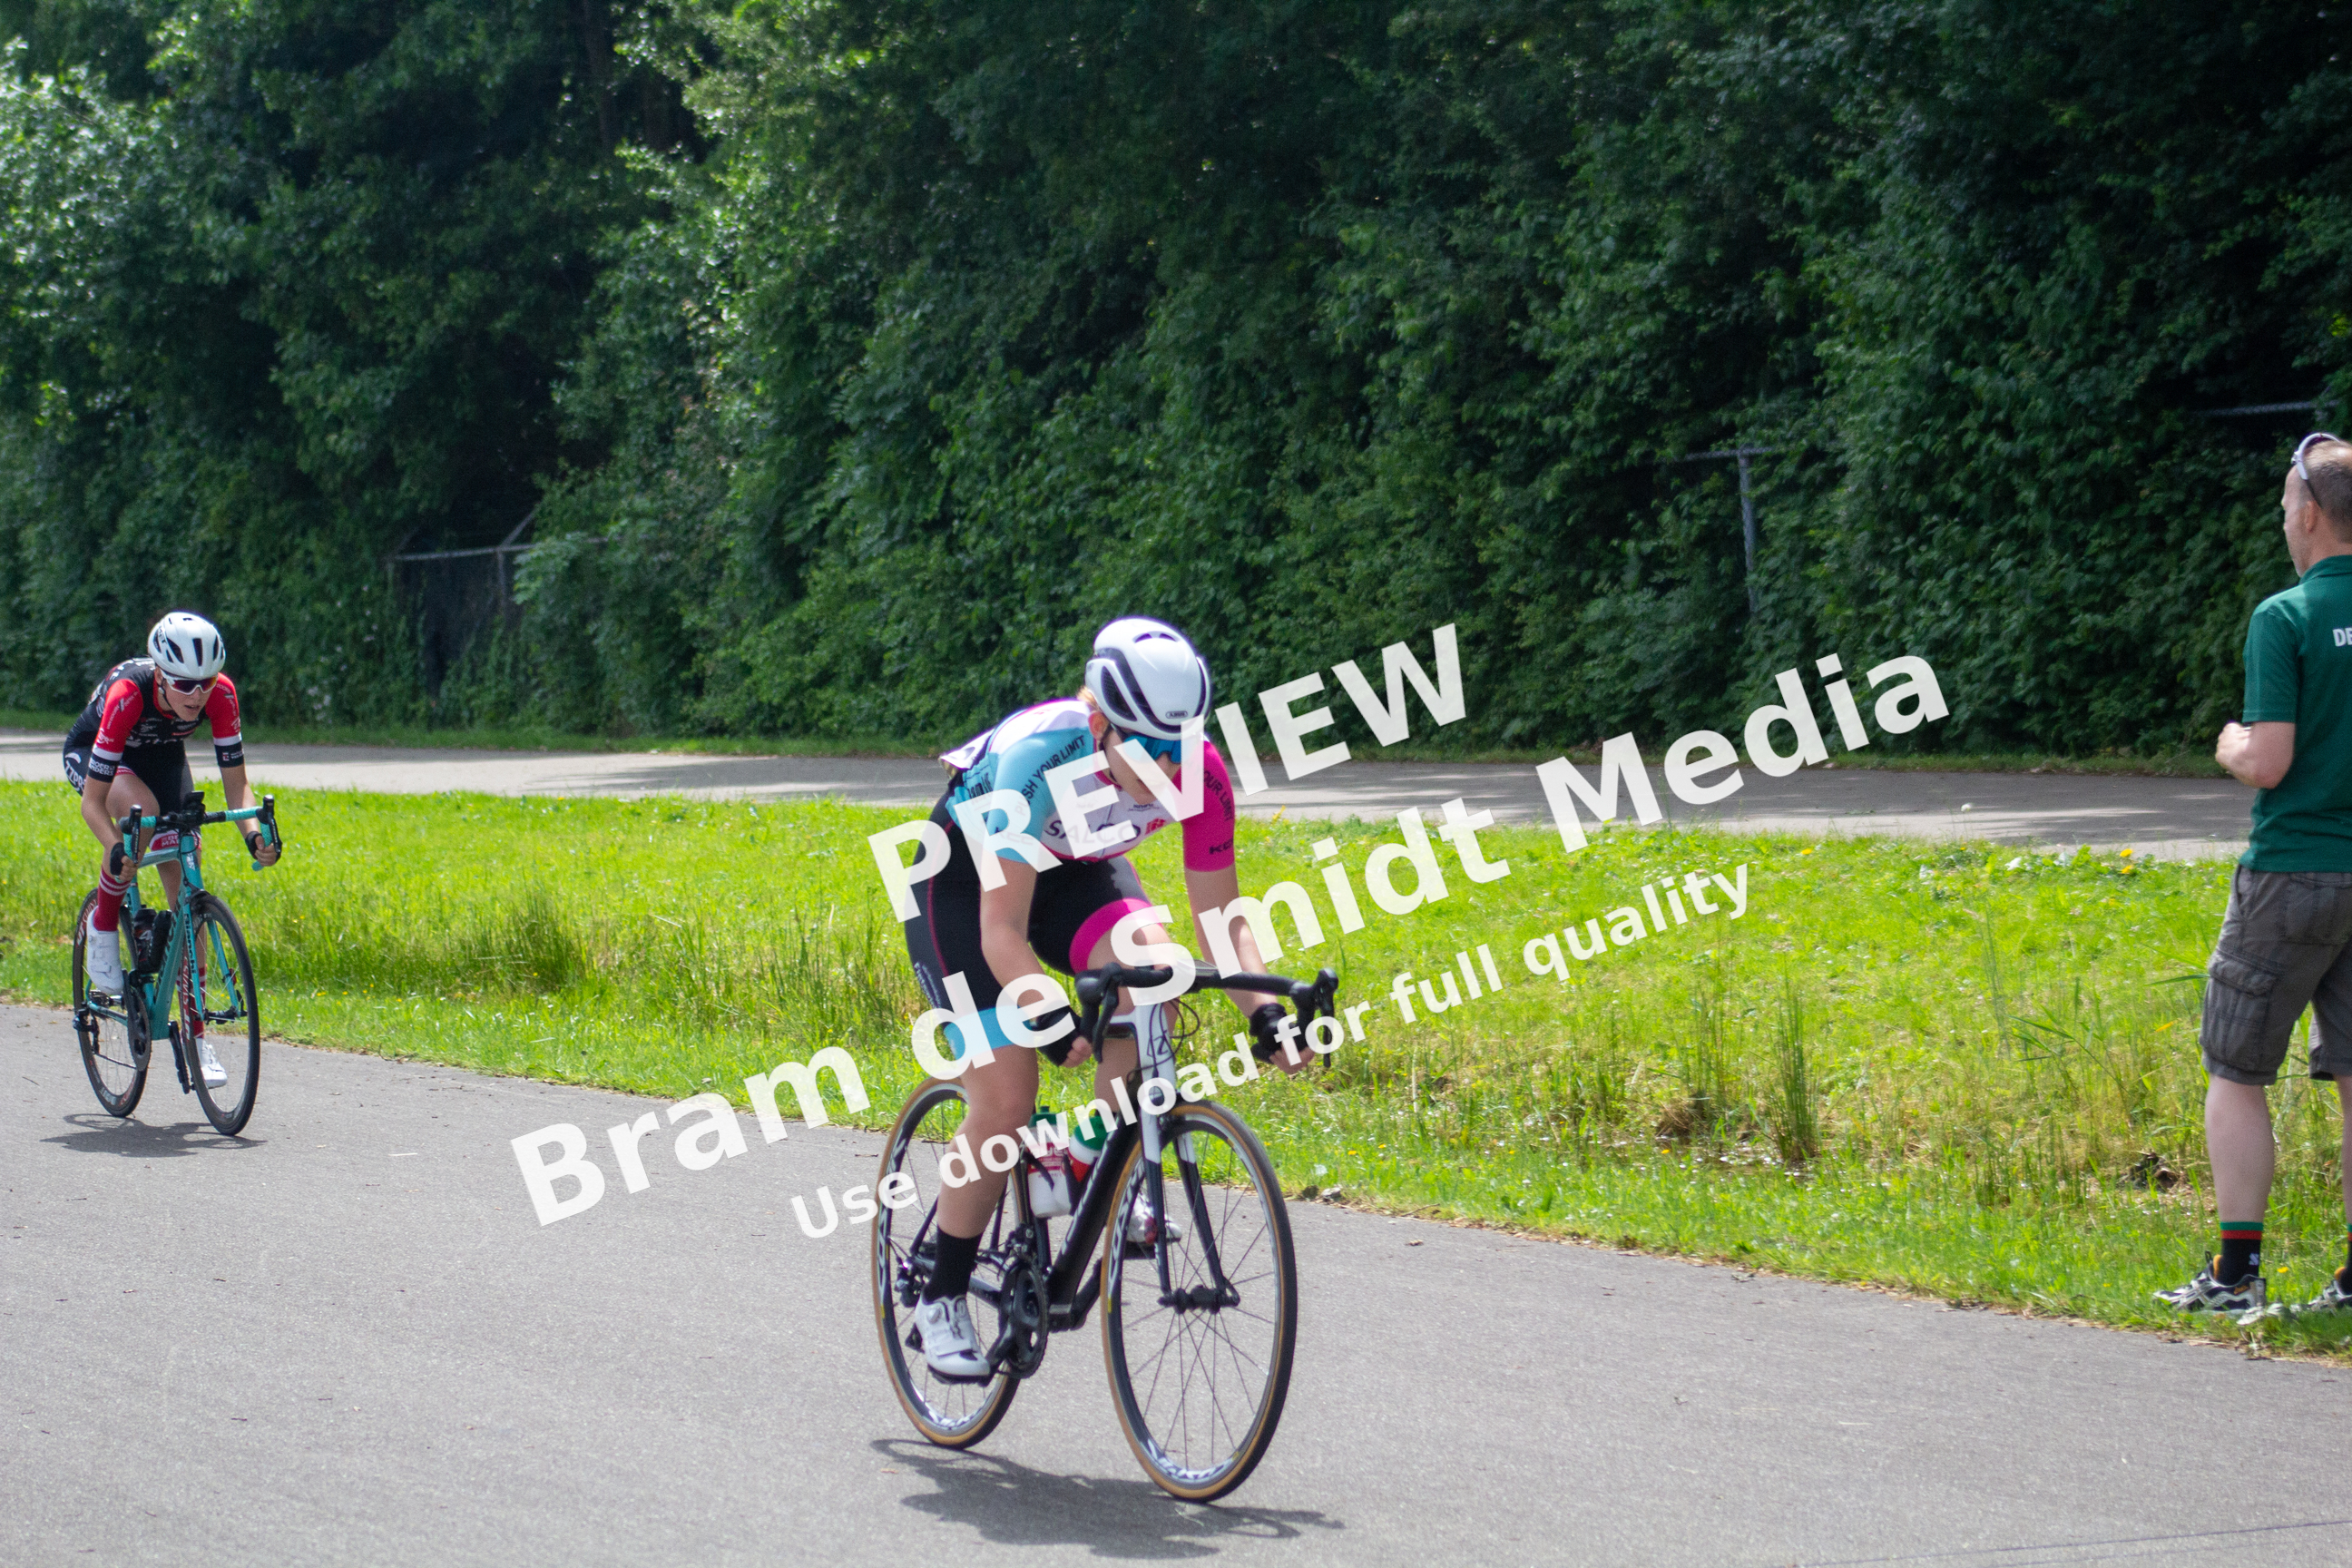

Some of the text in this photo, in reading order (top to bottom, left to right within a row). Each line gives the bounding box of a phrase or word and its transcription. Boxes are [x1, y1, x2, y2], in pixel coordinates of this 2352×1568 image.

[1034, 754, 1062, 783] YOUR
[1060, 735, 1085, 760] LIMIT
[184, 913, 197, 974] Bianchi
